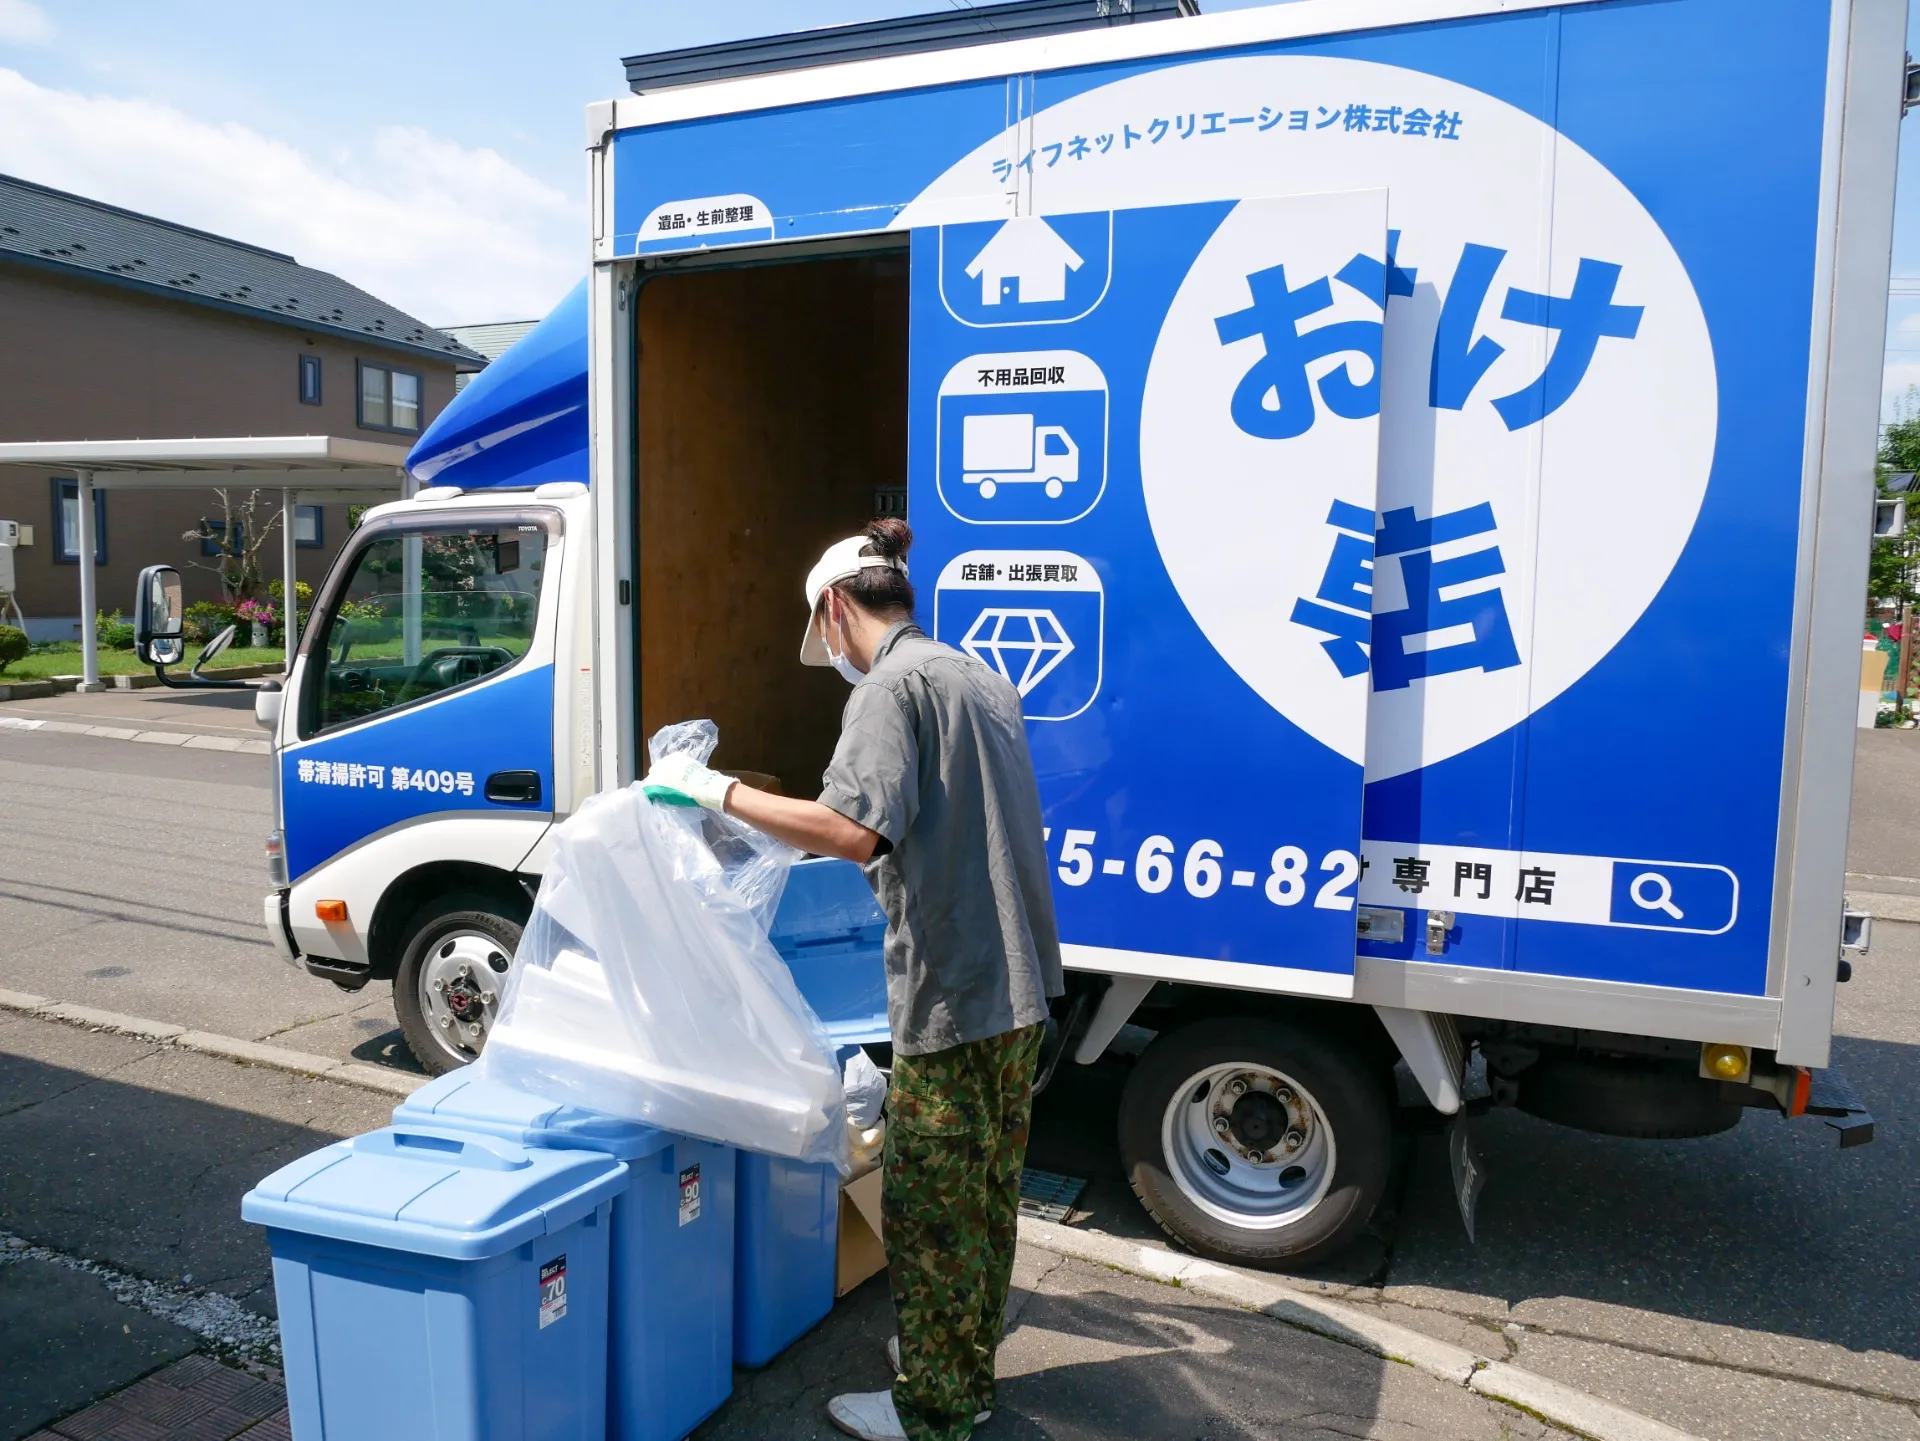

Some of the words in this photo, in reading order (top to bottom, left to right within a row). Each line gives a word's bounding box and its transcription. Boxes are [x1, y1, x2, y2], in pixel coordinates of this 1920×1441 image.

[992, 102, 1463, 184] ライフネットクリエーション株式会社
[977, 366, 1066, 387] 不用品回収
[298, 759, 385, 789] 帯清掃許可
[391, 766, 475, 796] 第409号
[1043, 827, 1359, 911] 5-66-82
[1360, 854, 1556, 906] 専門店
